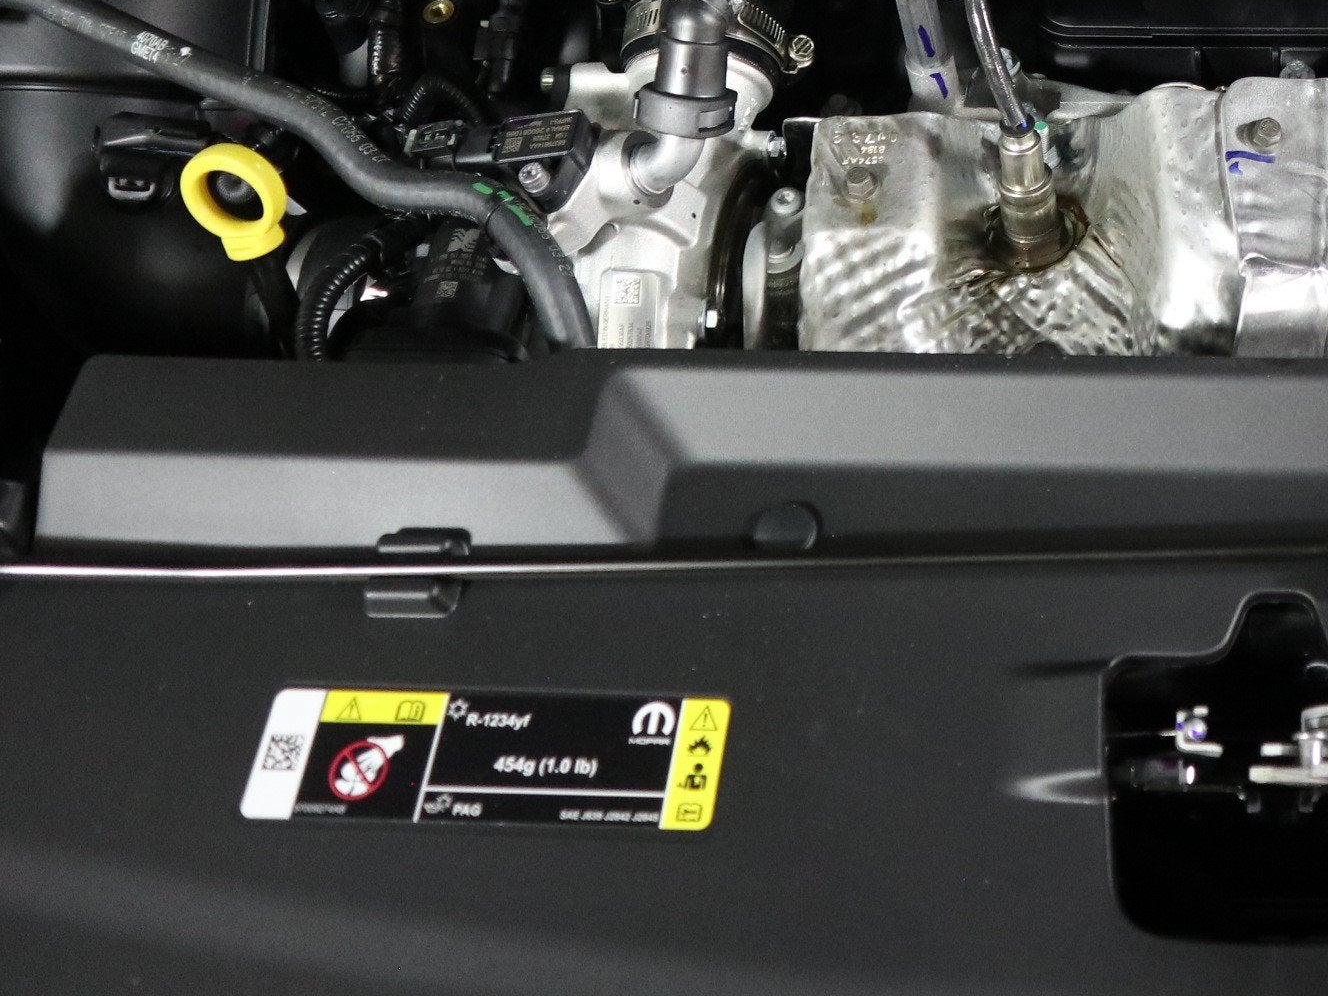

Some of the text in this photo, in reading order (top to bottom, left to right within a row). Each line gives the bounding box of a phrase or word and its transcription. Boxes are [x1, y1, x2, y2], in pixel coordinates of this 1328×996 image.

[466, 713, 532, 731] R-1234yf
[493, 756, 598, 778] 454g (1.0 lb)
[451, 803, 483, 817] PAG
